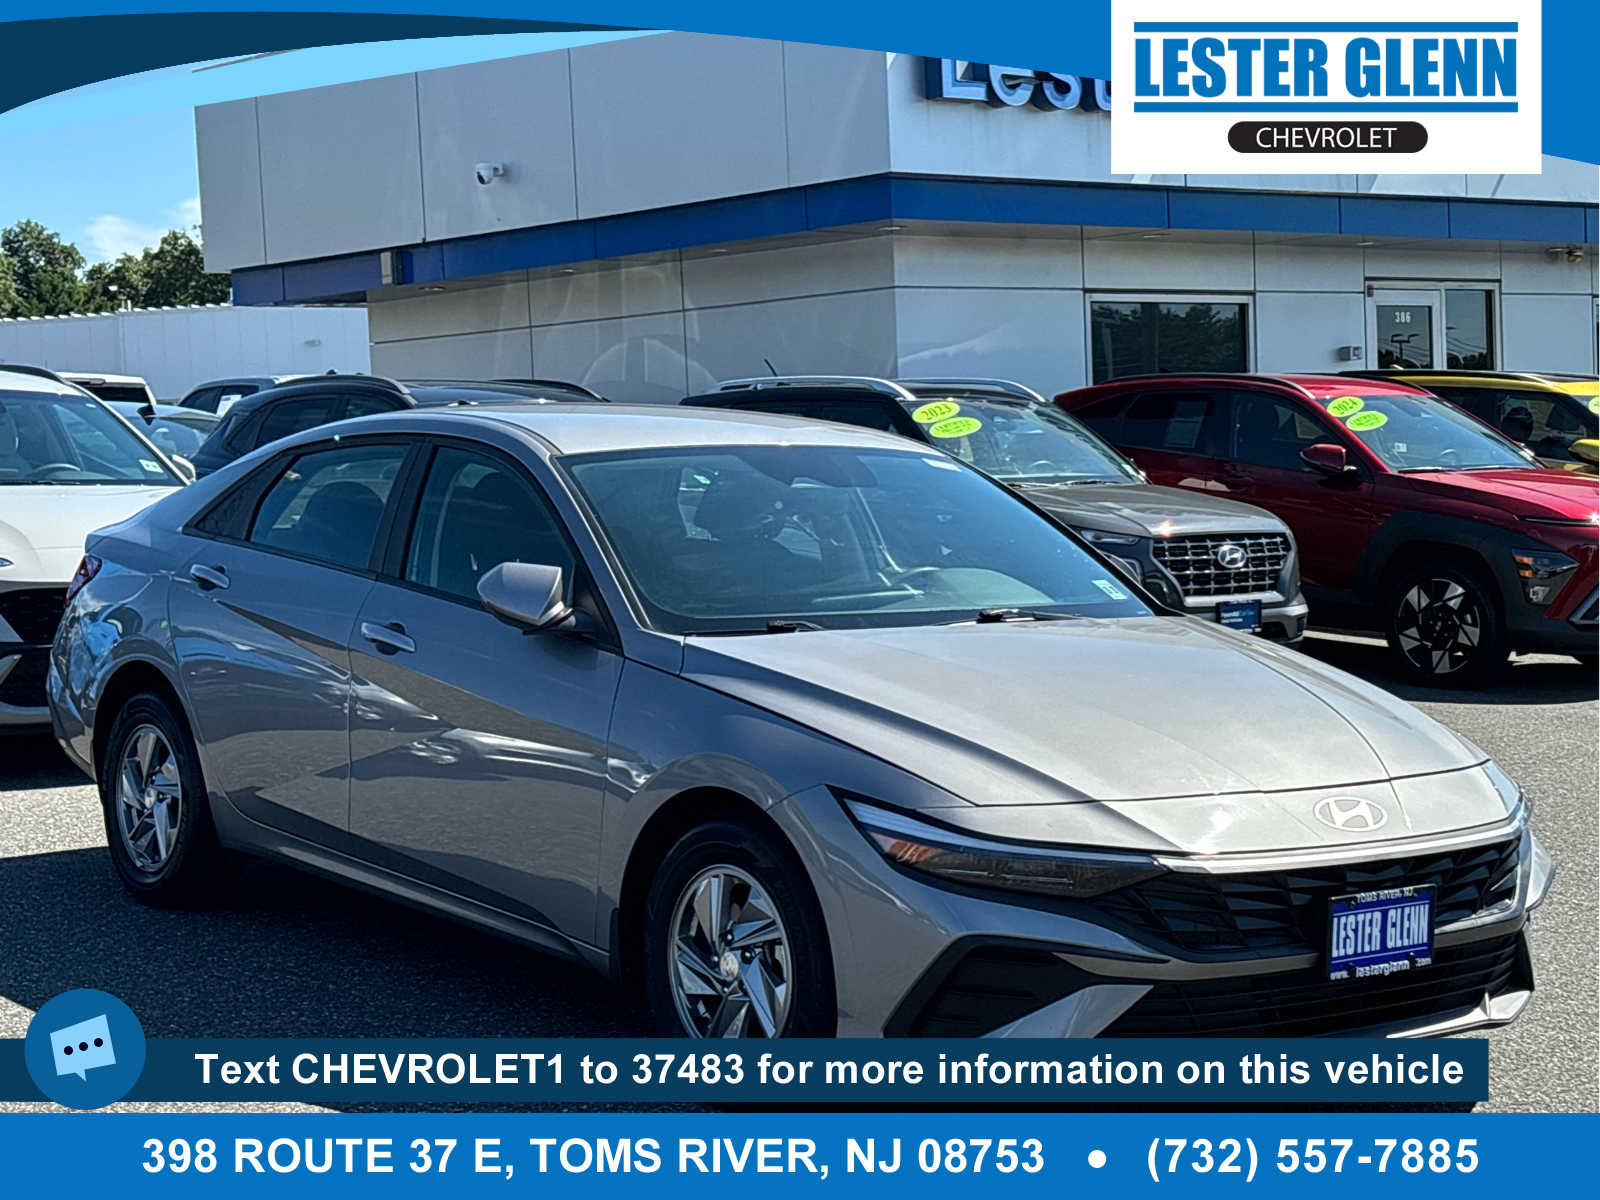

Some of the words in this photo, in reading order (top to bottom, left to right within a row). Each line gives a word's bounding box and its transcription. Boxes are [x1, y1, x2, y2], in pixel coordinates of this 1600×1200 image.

[920, 403, 953, 421] 2023
[1331, 911, 1382, 958] LESTER
[1386, 904, 1430, 949] GLENN
